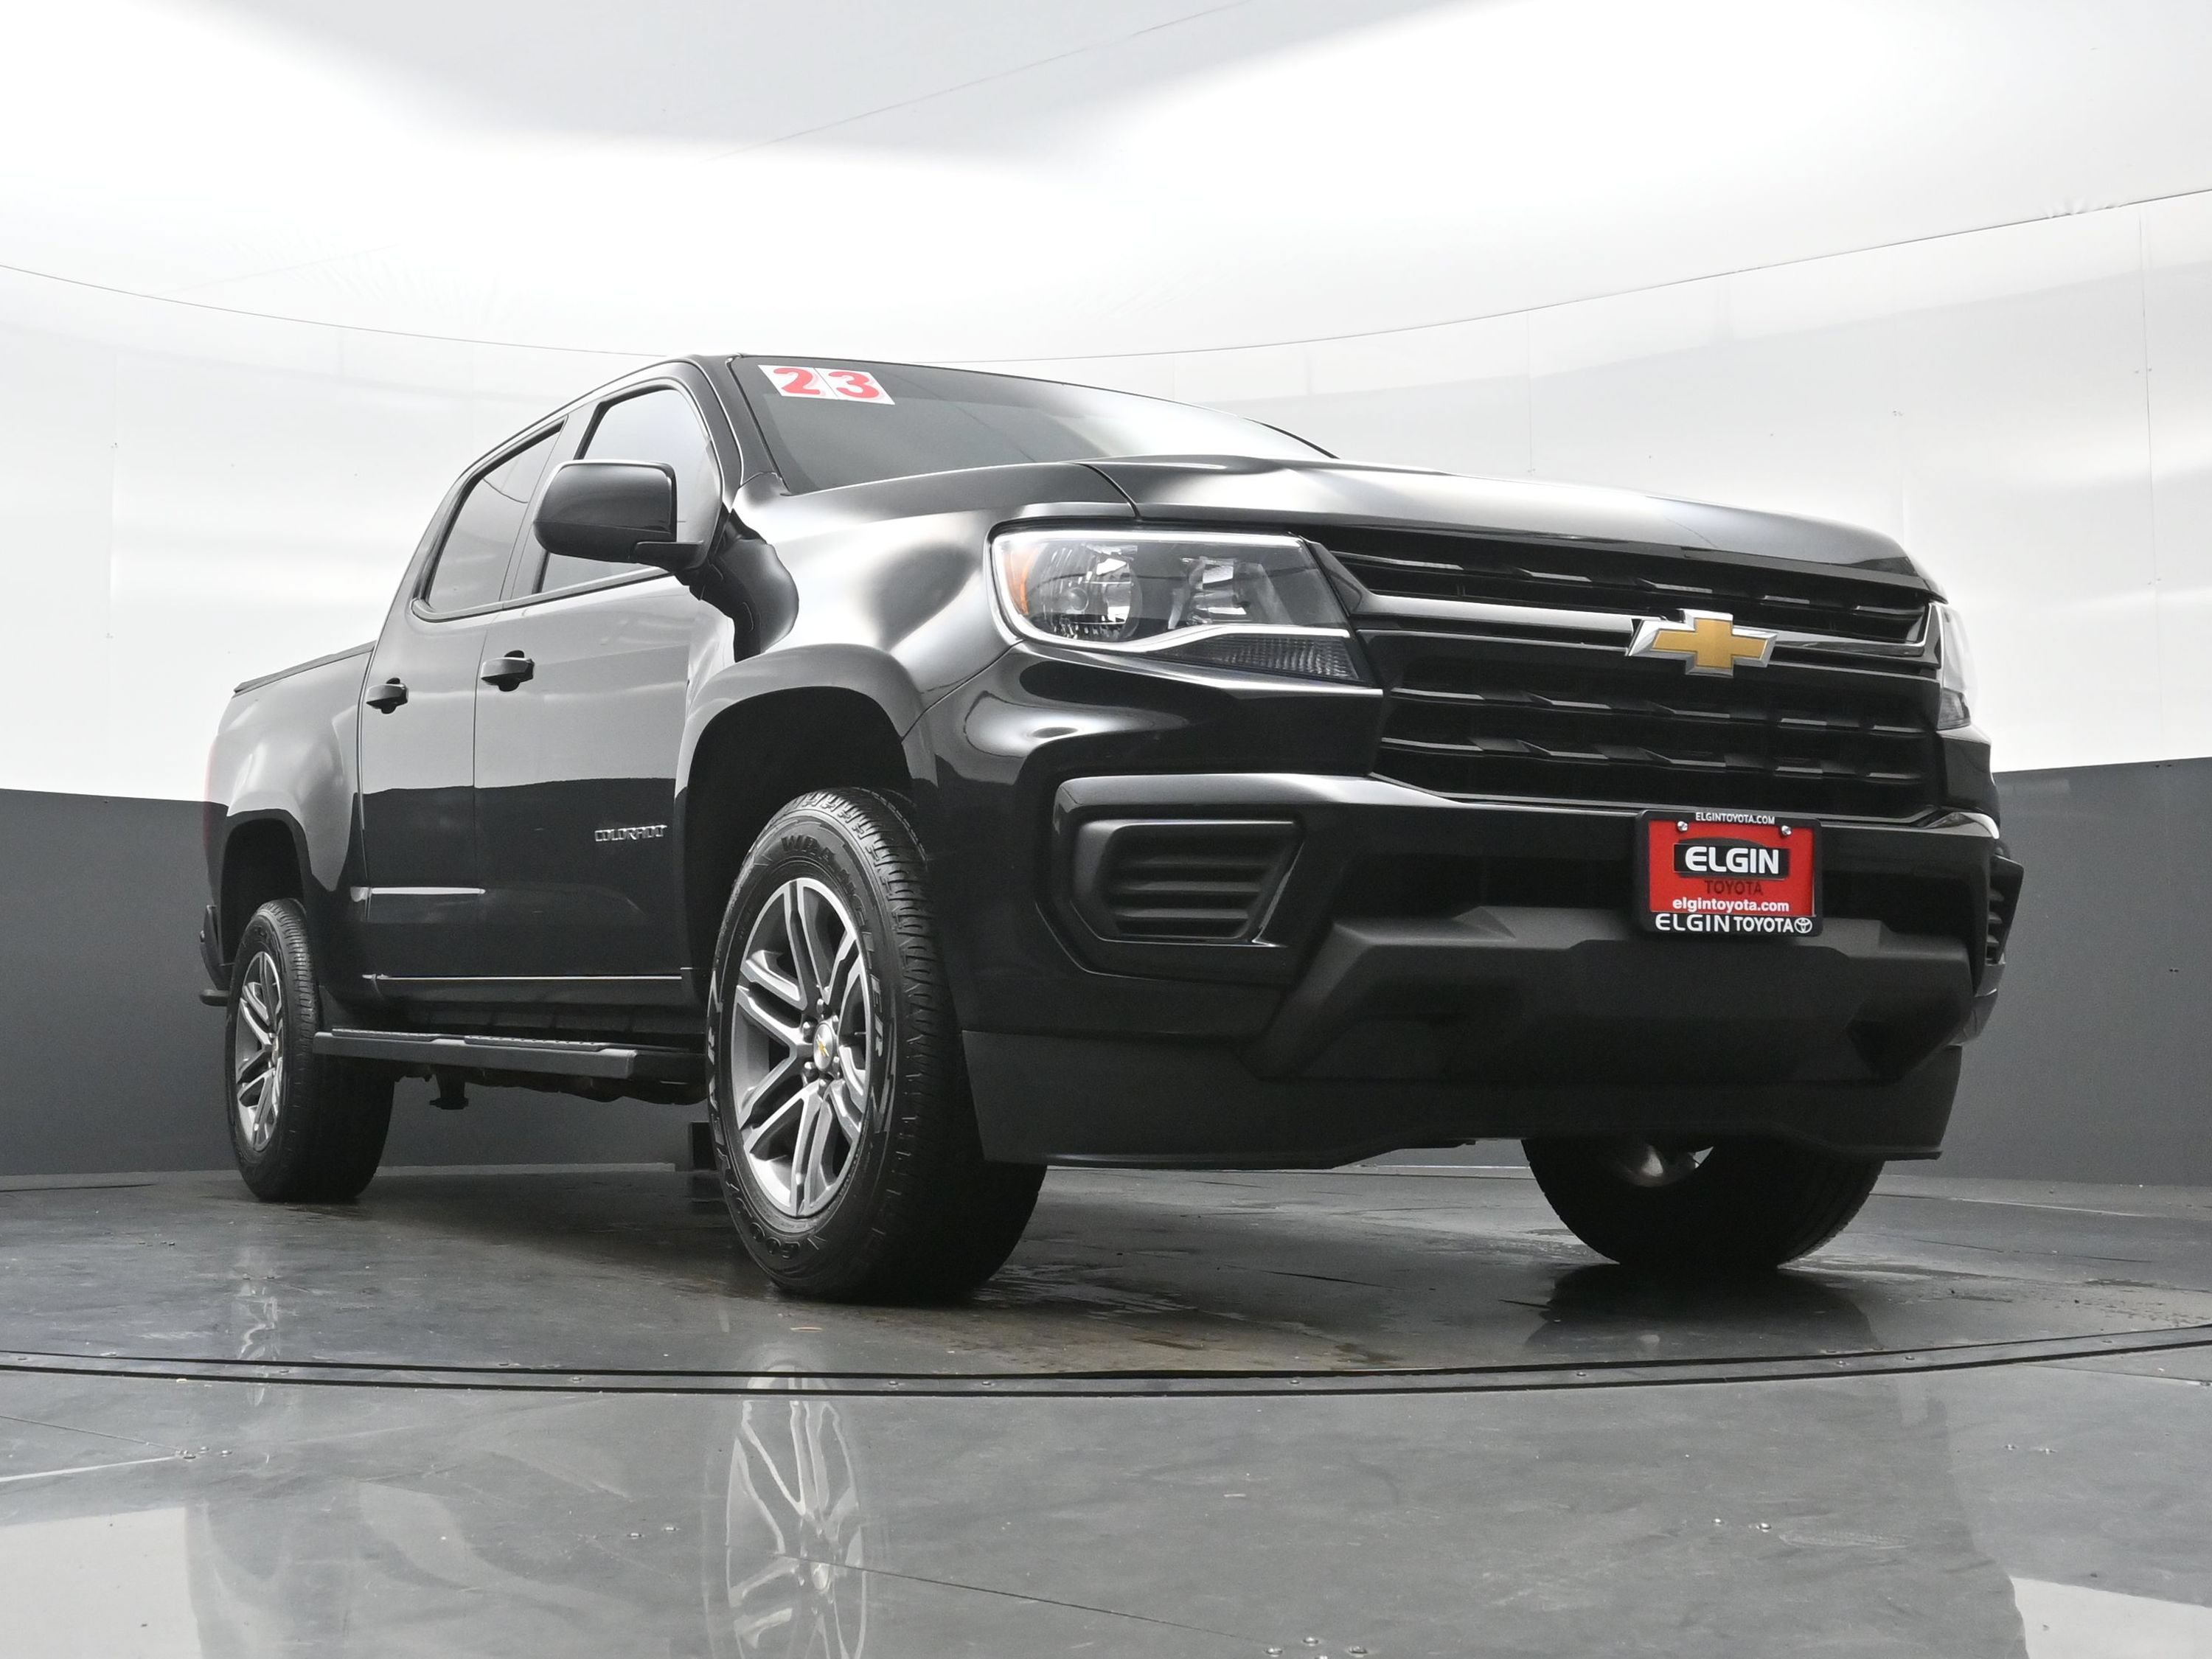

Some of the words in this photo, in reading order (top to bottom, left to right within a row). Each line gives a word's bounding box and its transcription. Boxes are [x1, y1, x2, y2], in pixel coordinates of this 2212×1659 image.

[773, 366, 882, 399] 23
[1695, 812, 1775, 824] ELGINTOYOTA.COM
[1684, 846, 1779, 874] ELGIN
[1703, 880, 1764, 896] TOYOTA
[1672, 897, 1790, 913] elgintoyota.com
[1655, 913, 1731, 933] ELGIN
[1733, 917, 1794, 933] TOYOTA
